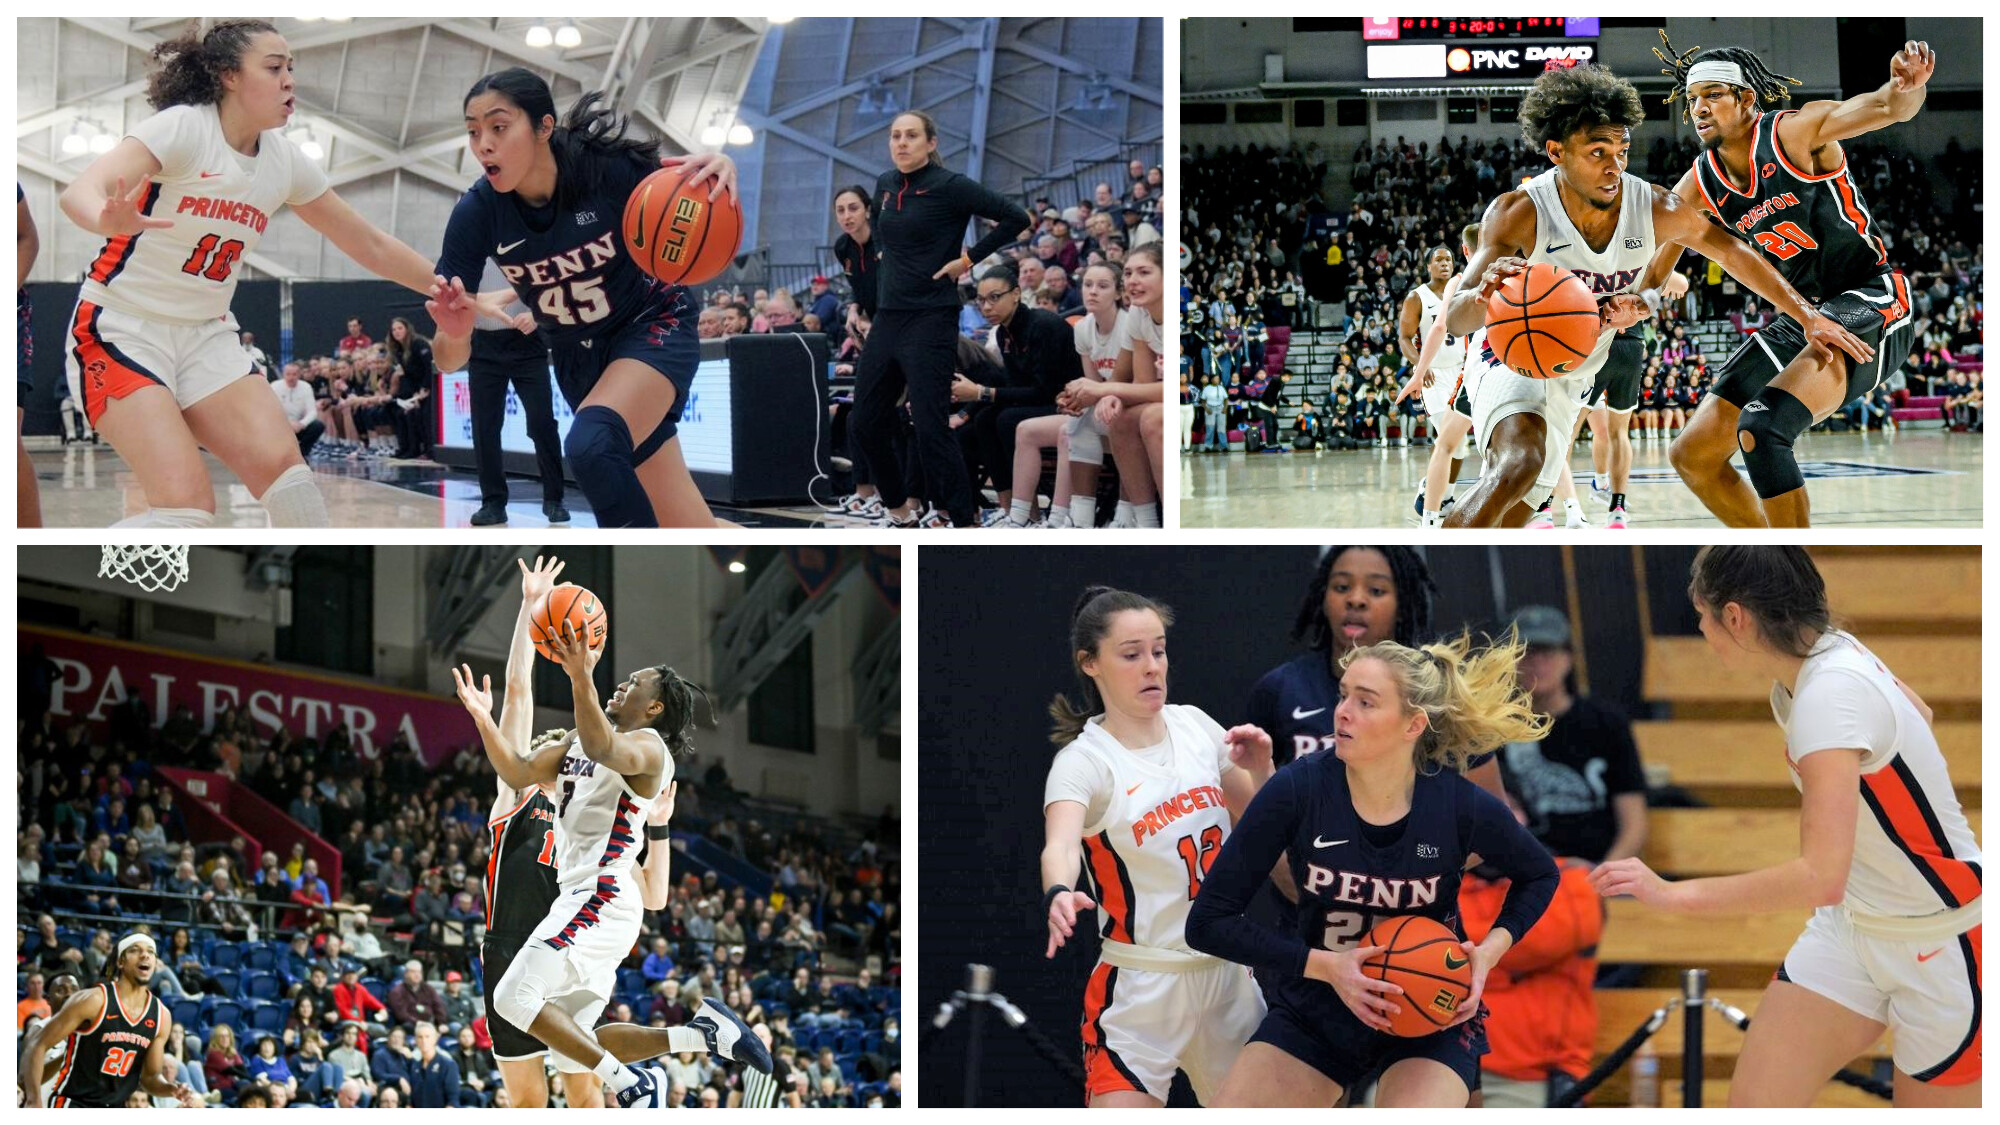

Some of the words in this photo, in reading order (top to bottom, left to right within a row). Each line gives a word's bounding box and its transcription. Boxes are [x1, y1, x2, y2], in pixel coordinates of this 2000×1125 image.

[1472, 50, 1520, 69] PNC
[1524, 46, 1593, 61] DAVID
[661, 197, 697, 263] ELITE
[1735, 192, 1801, 234] PRINCETON
[182, 233, 244, 282] 10
[500, 231, 616, 286] PENN
[1754, 221, 1819, 261] 20
[538, 275, 612, 325] 45
[1571, 266, 1643, 294] ENN
[558, 755, 597, 777] ENN
[1304, 863, 1442, 909] PENN
[1323, 910, 1388, 952] 2
[101, 1046, 138, 1077] 20
